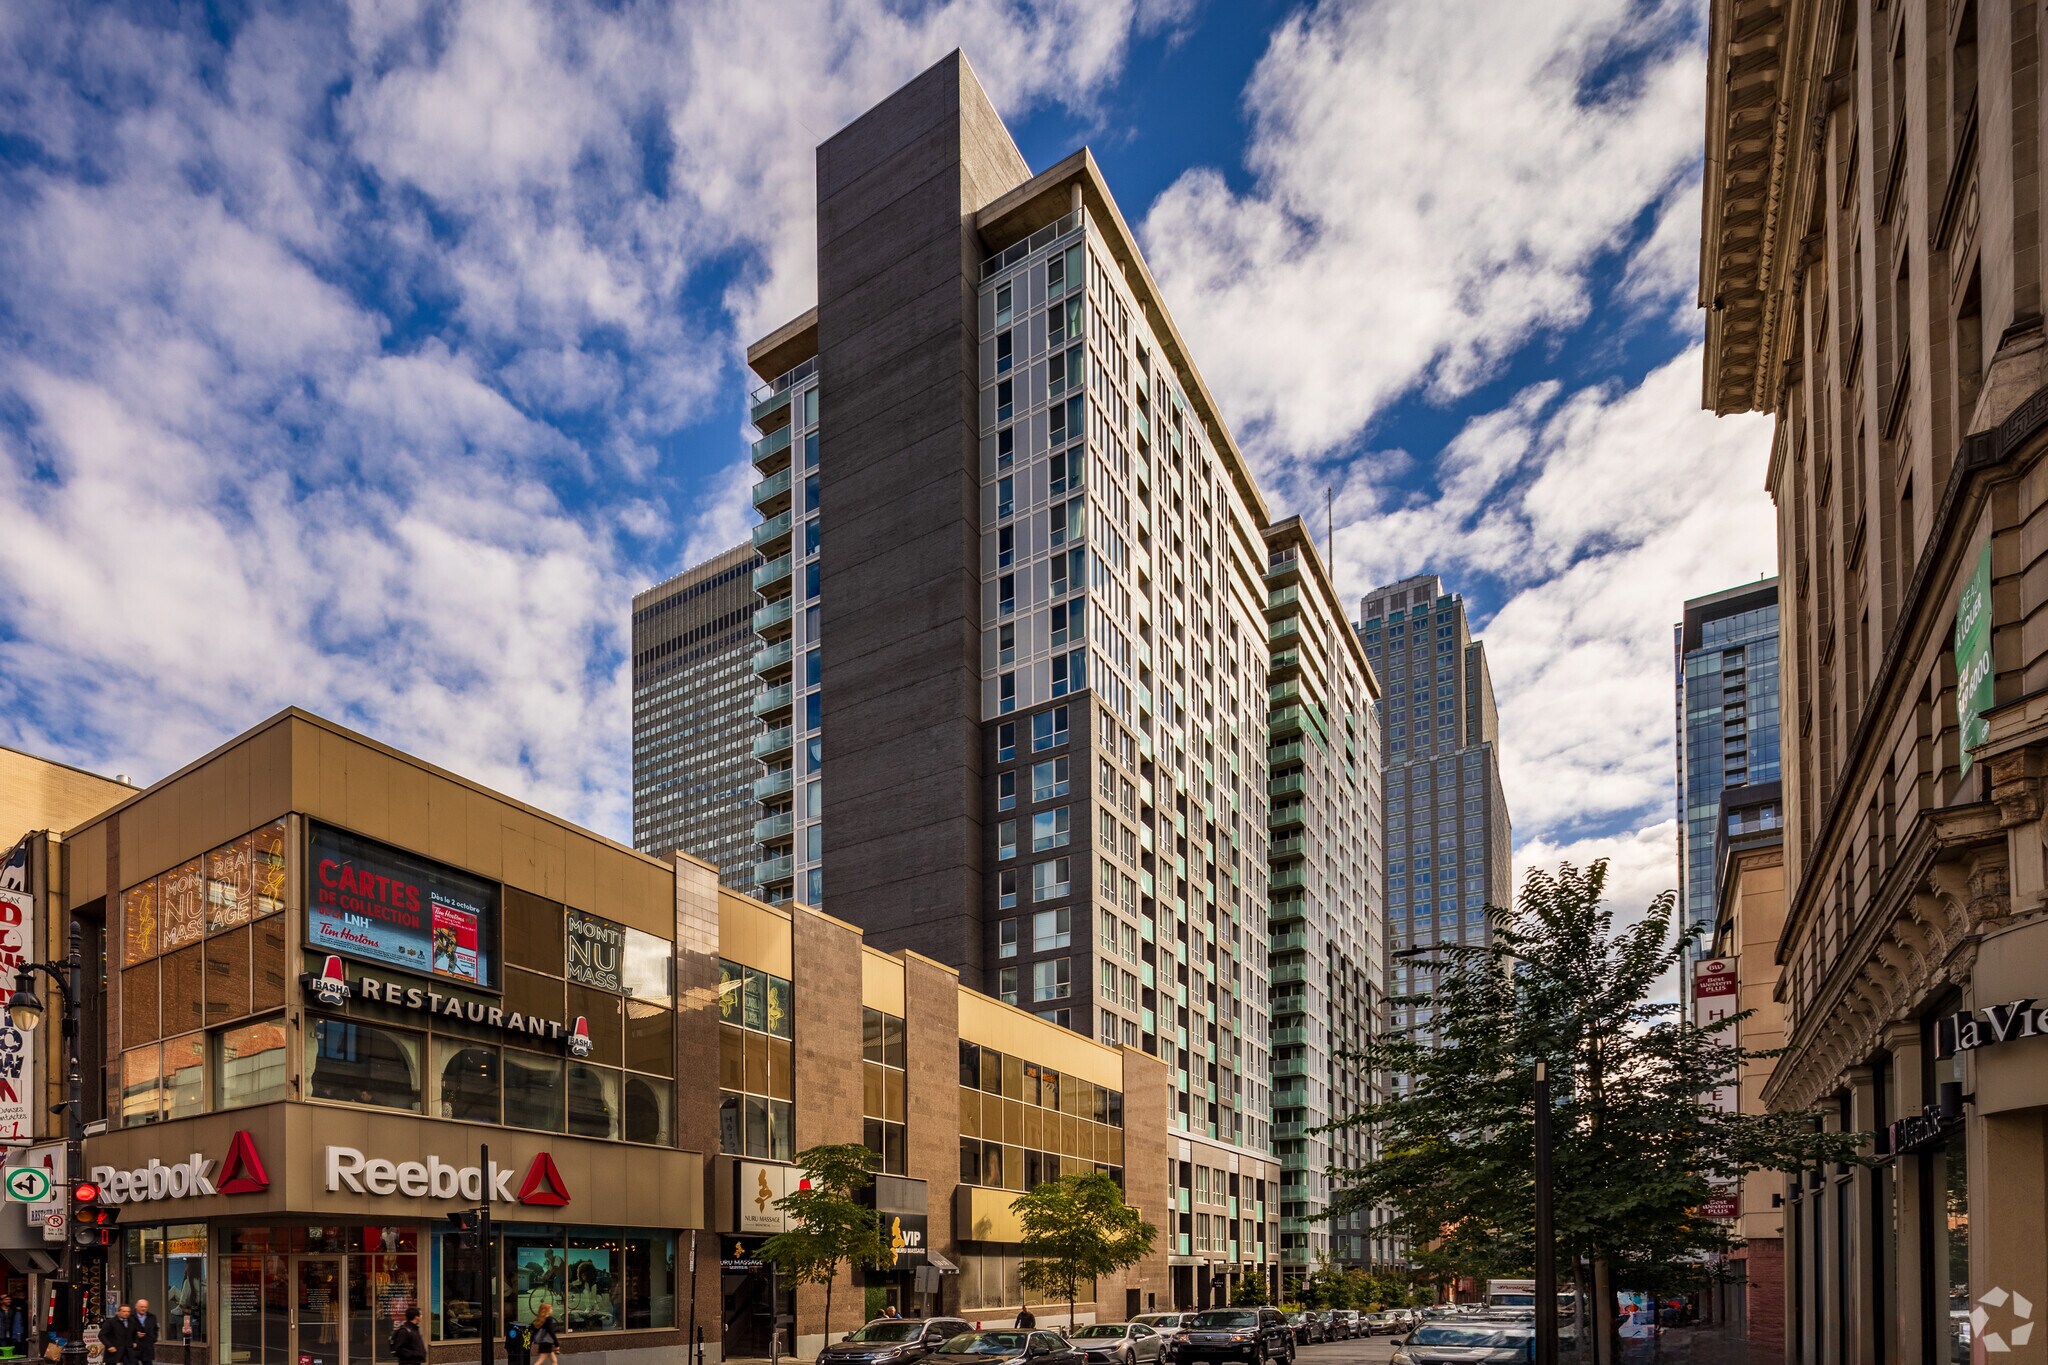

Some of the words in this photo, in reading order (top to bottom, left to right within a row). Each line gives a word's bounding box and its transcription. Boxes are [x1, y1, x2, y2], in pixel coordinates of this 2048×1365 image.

[1961, 592, 1982, 641] LOUER
[1968, 650, 1990, 699] 6000
[318, 858, 421, 912] CARTES
[431, 891, 444, 902] Dès
[451, 898, 456, 906] 2
[456, 901, 480, 914] octobre
[163, 898, 251, 949] MASSAGE
[318, 888, 337, 906] DE
[339, 894, 420, 929] COLLECTION
[319, 921, 339, 938] Tim
[340, 927, 380, 948] Hortons
[1700, 980, 1732, 988] Western
[315, 979, 351, 998] BASHA
[362, 976, 563, 1039] RESTAURANT
[1951, 1012, 1983, 1053] la
[92, 1152, 217, 1206] Reebok
[325, 1145, 516, 1203] Reebok
[744, 1215, 759, 1223] NURU
[759, 1215, 780, 1224] MASSAGE
[902, 1231, 921, 1247] VIP
